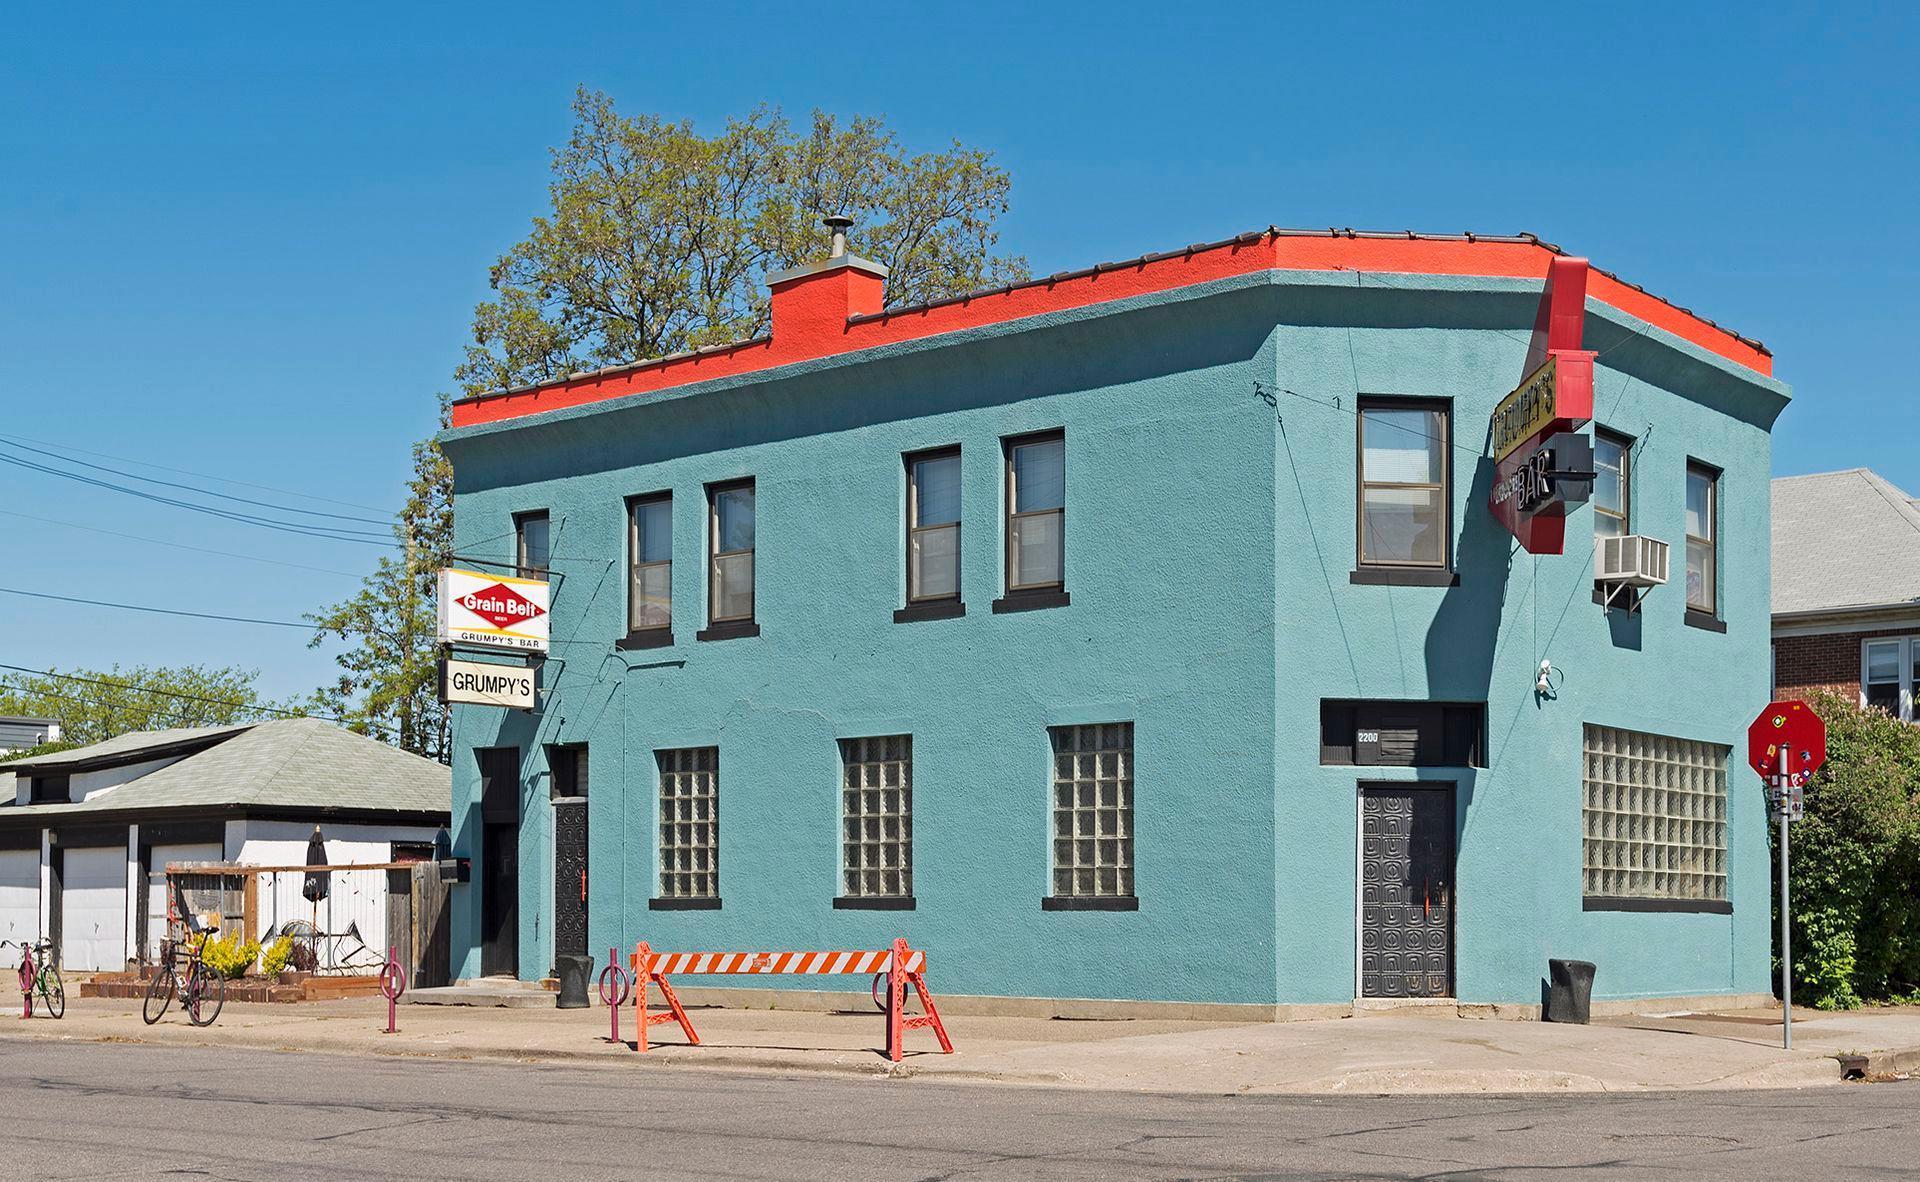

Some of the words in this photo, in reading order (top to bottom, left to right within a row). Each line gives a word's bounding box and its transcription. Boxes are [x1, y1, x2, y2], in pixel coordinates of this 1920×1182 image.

[1517, 449, 1550, 510] BAR
[464, 594, 504, 613] Grain
[507, 598, 536, 617] Belt
[461, 632, 513, 645] GRUMPY'S
[520, 639, 539, 648] BAR
[453, 672, 530, 696] GRUMPY'S
[1358, 732, 1378, 743] 2200
